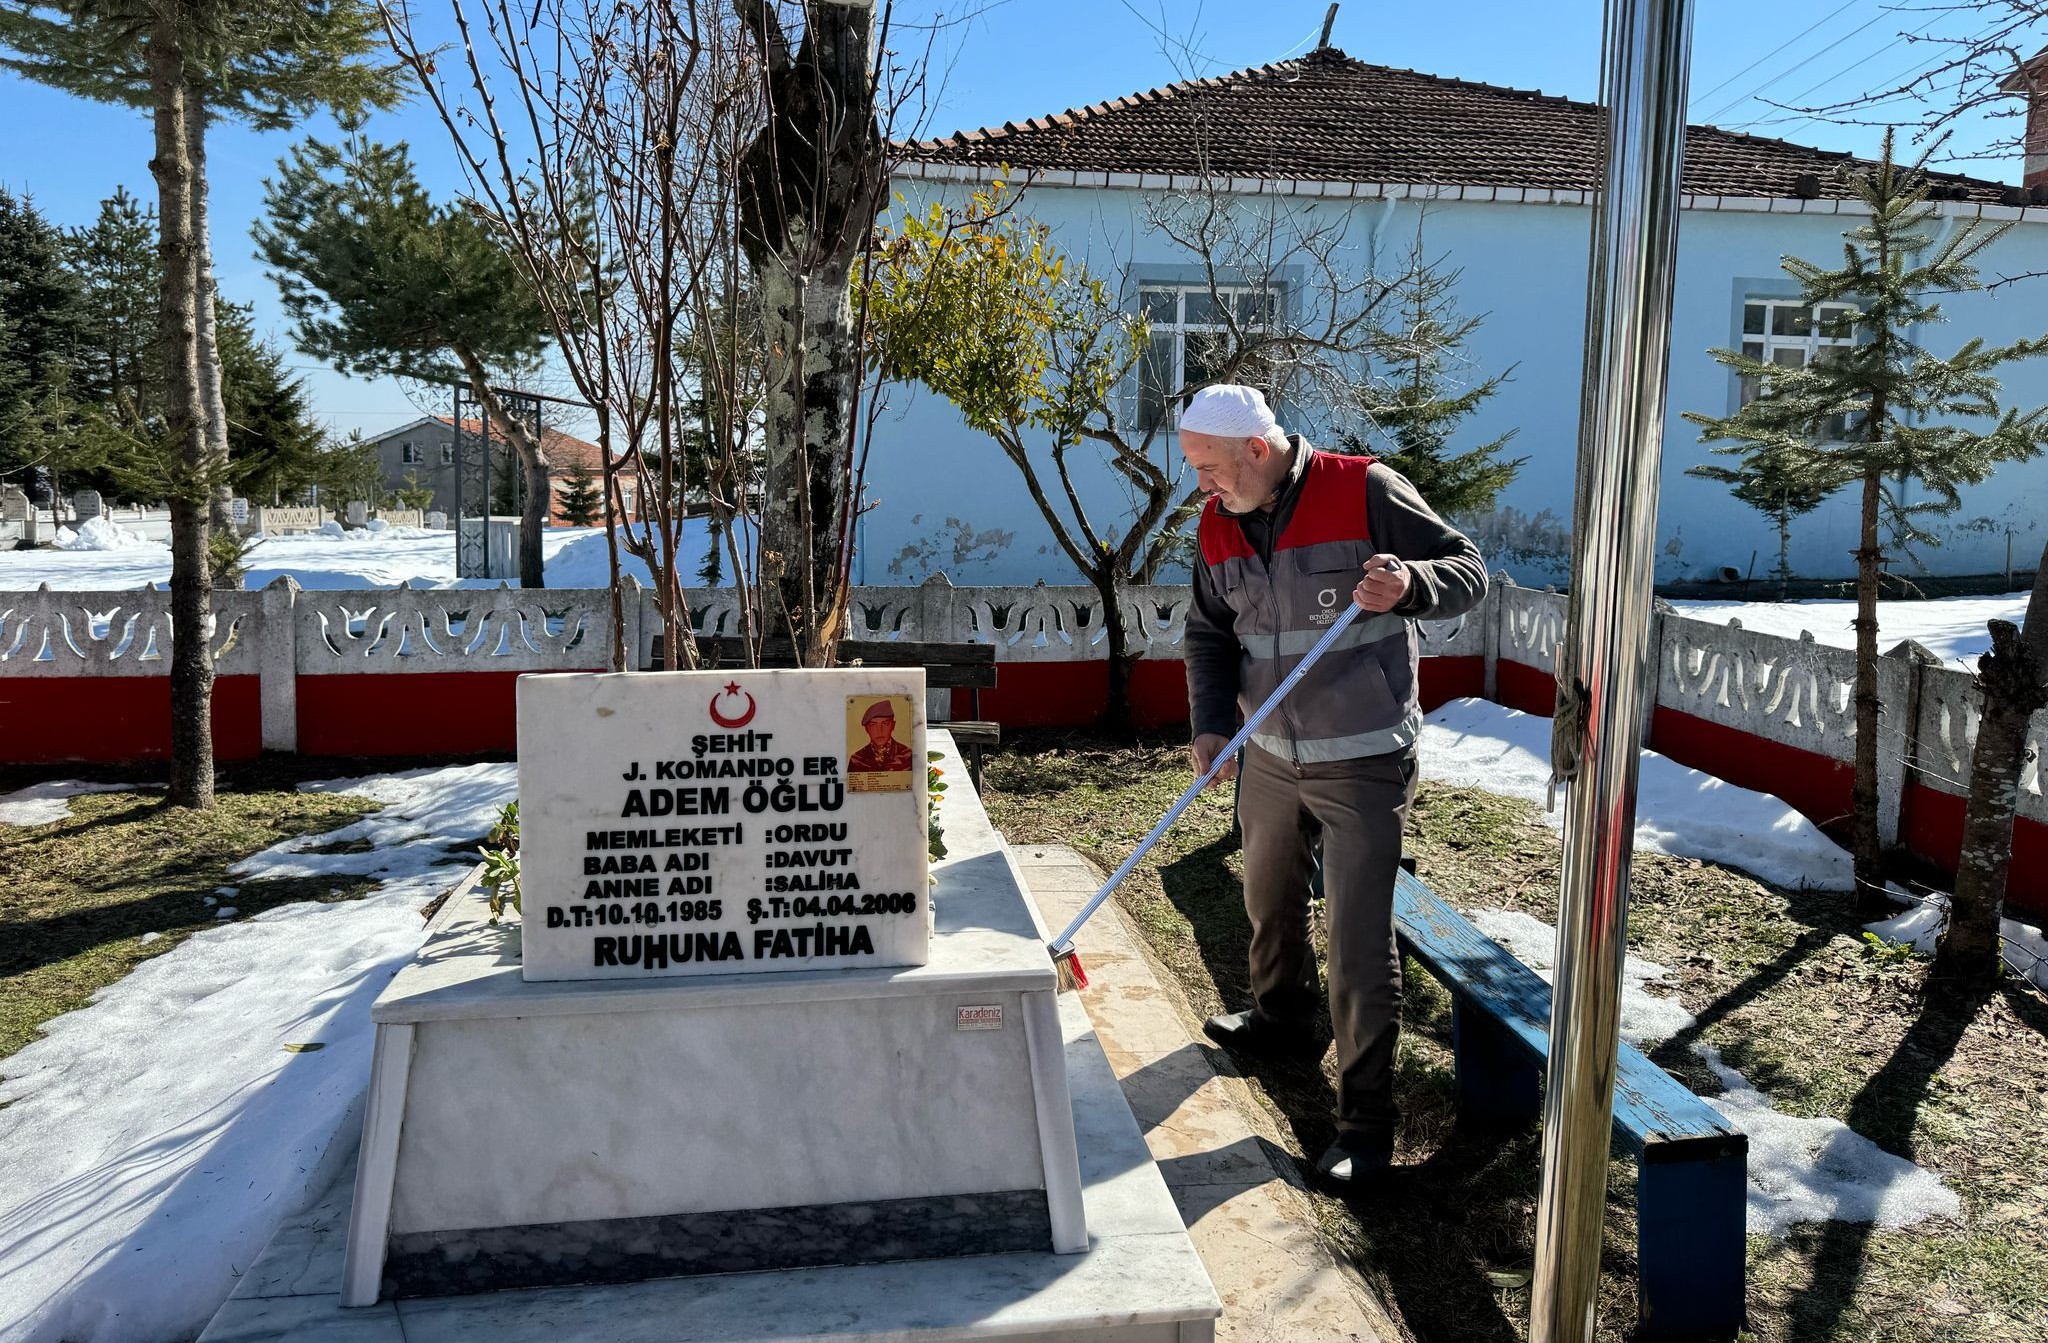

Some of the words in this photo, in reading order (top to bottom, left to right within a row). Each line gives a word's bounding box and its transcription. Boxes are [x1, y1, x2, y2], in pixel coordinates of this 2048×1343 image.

[691, 729, 773, 759] ŞEHİT
[622, 761, 647, 781] J.
[656, 757, 795, 780] KOMANDO
[803, 757, 839, 776] ER
[621, 786, 730, 818] ADEM
[742, 777, 845, 814] ÖĞLÜ
[586, 822, 743, 851] MEMLEKETİ
[583, 854, 657, 876] BABA
[663, 852, 710, 873] ADI
[582, 877, 660, 900] ANNE
[666, 876, 713, 896] ADI
[593, 930, 745, 971] RUHUNA
[753, 922, 875, 960] FATİHA
[959, 1007, 1001, 1019] Karadeniz
